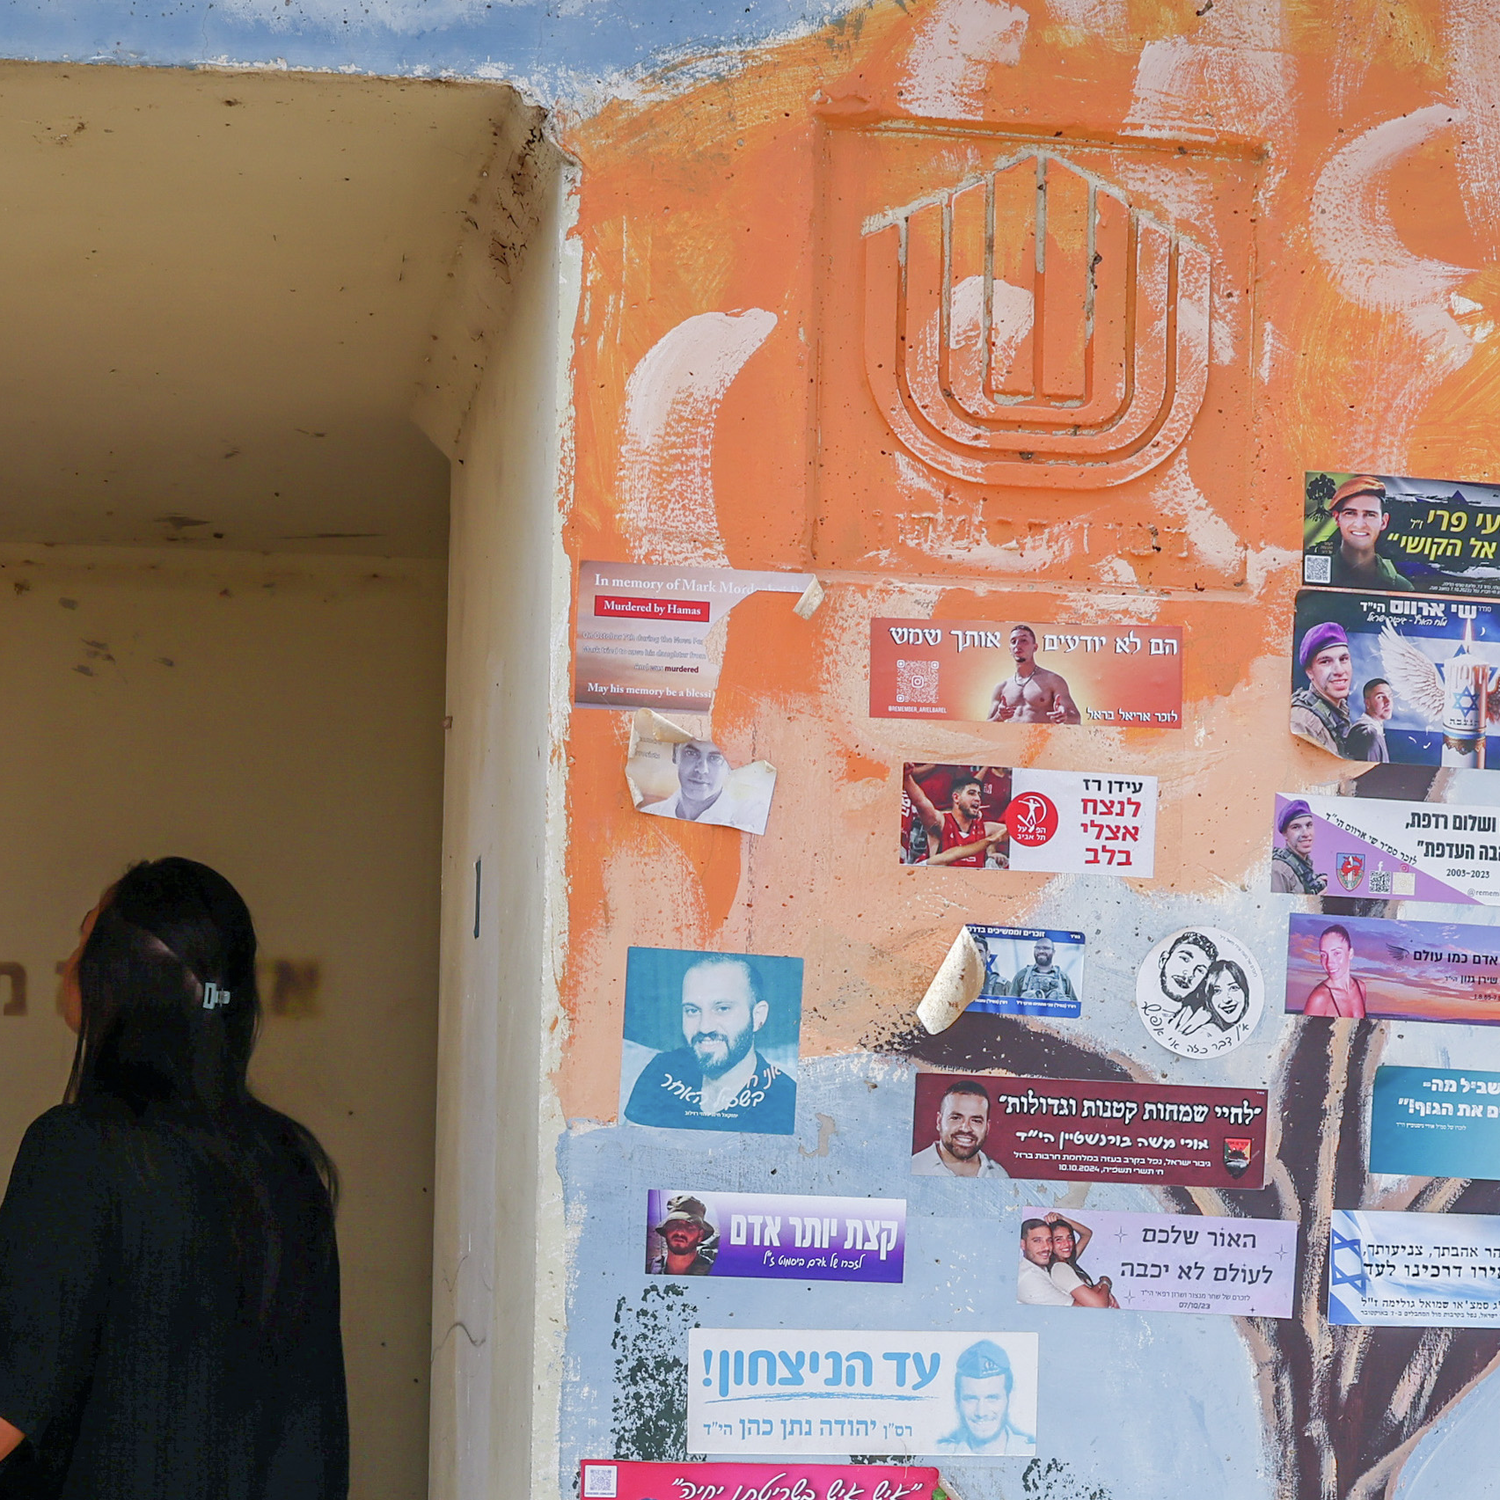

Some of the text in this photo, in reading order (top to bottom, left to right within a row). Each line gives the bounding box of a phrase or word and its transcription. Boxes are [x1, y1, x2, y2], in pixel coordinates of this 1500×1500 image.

[1427, 509, 1467, 532] פרי
[1387, 532, 1461, 561] הקושי"
[1470, 539, 1496, 559] אל
[594, 573, 715, 593] In memory of Mark
[604, 600, 701, 616] Murdered by Hamas
[1390, 599, 1445, 616] ארווס
[1451, 604, 1477, 619] שי
[889, 627, 1177, 655] הם לא יודעים אותך שמש
[587, 683, 608, 694] May
[610, 684, 624, 694] his
[626, 687, 663, 699] memory
[666, 687, 678, 697] be
[1086, 707, 1177, 722] לזכר אריאל בראל
[1083, 779, 1143, 794] עידן רז
[1081, 797, 1141, 818] לנצח
[1405, 811, 1448, 830] רדפת,
[1452, 814, 1496, 833] ושלום
[1081, 820, 1139, 842] אצלי
[1084, 845, 1132, 866] בלב
[1416, 839, 1475, 860] העדפת"
[1446, 869, 1490, 879] 2003-2023
[1413, 949, 1443, 962] עולם
[1447, 952, 1468, 966] כמו
[1473, 953, 1498, 966] אדם
[999, 1089, 1262, 1125] "לחיי שמחות קטנות וגדולות"
[1456, 1103, 1483, 1117] את
[1058, 1163, 1100, 1173] 10.10.2024
[729, 1214, 899, 1261] קצת יותר אדם
[1142, 1224, 1200, 1246] שלכם
[1363, 1243, 1424, 1258] צניעותך,
[1430, 1244, 1478, 1259] אהבתך,
[1120, 1261, 1170, 1278] יכבה
[1177, 1261, 1205, 1281] לא
[1363, 1260, 1397, 1277] לעד
[1403, 1263, 1463, 1278] דרכינו
[1178, 1302, 1211, 1310] 07/10/23
[702, 1349, 941, 1398] עד הניצחון!
[738, 1417, 878, 1441] יהודה נתן כהן
[671, 1477, 725, 1499] יחיה"
